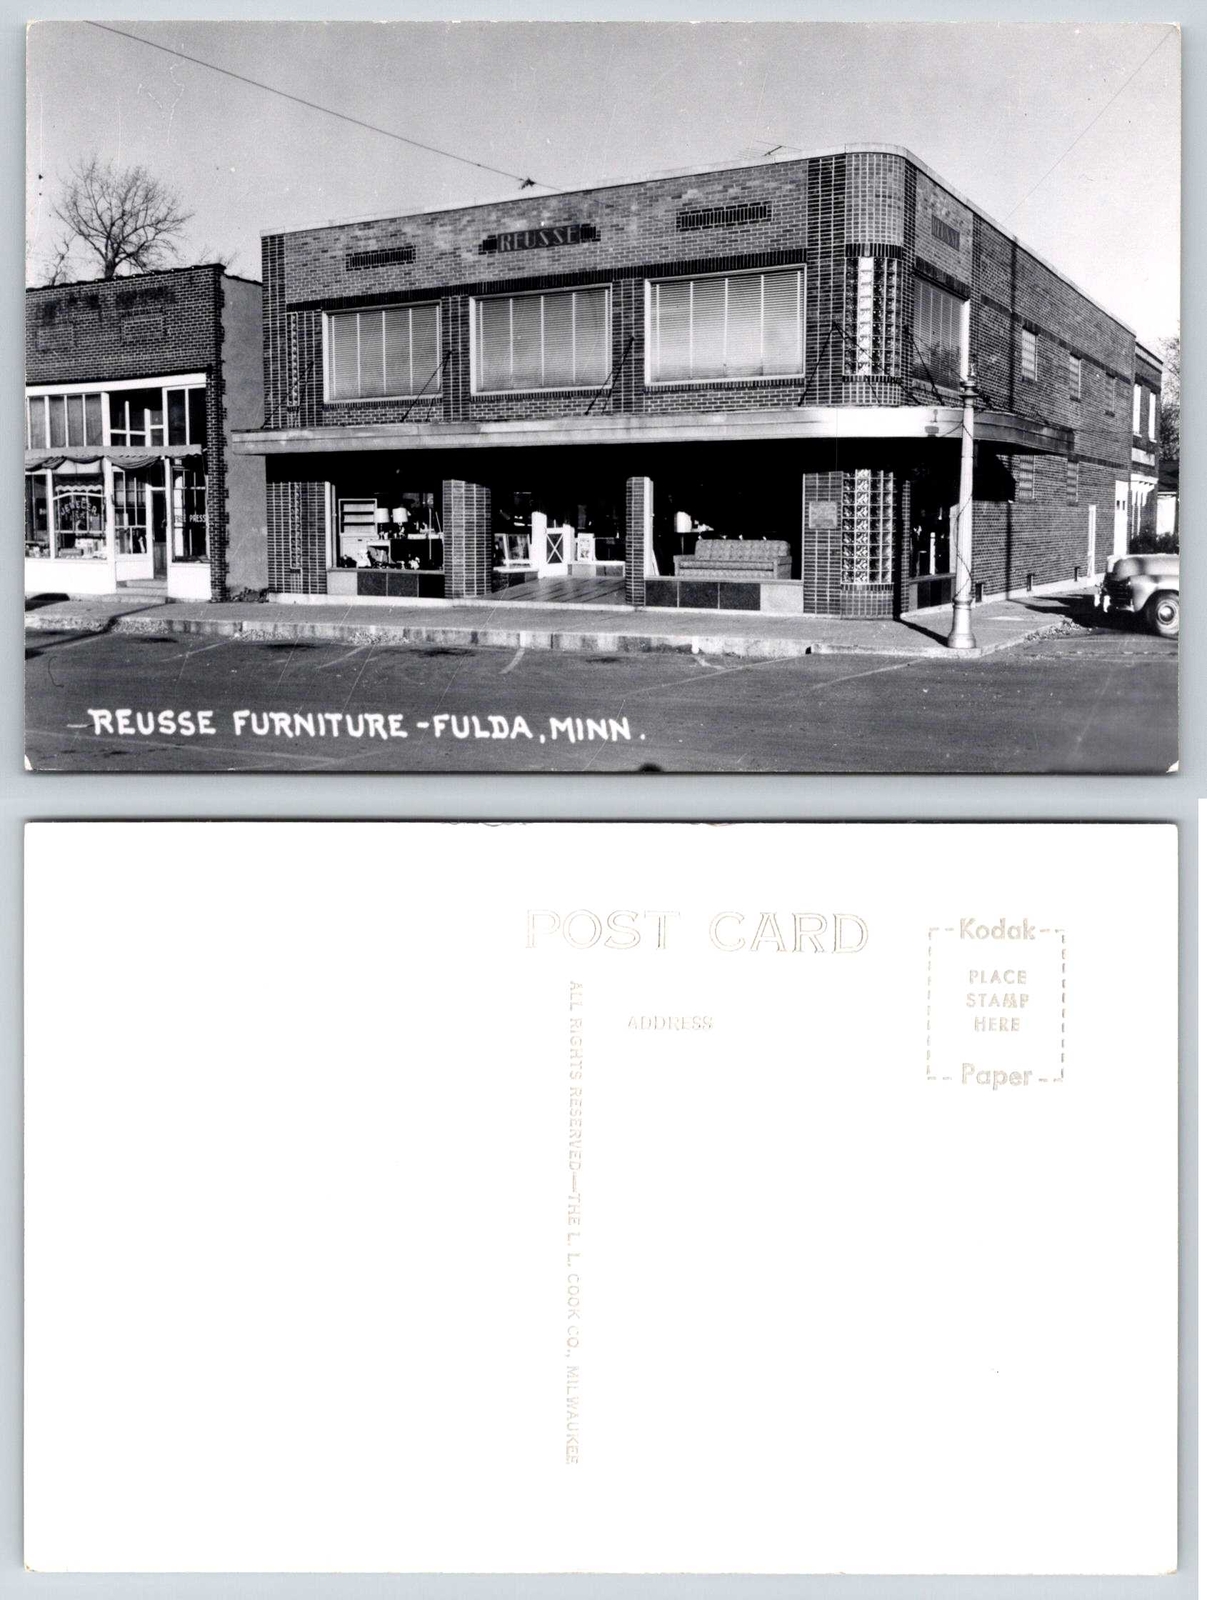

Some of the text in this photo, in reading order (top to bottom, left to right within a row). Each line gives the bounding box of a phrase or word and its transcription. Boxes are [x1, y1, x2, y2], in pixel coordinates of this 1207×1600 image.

[500, 226, 577, 251] REUSSE
[189, 514, 207, 523] PRESS
[525, 909, 869, 955] POST CARD
[959, 917, 1036, 941] Kodak
[968, 969, 1027, 985] PLACE
[569, 980, 584, 1012] ALL
[965, 992, 1030, 1009] STAMP
[627, 1015, 714, 1032] ADDRESS
[974, 1016, 1020, 1033] HERE
[568, 1017, 584, 1080] RIGHTS
[961, 1062, 1033, 1092] Paper
[566, 1231, 581, 1247] L.
[566, 1252, 581, 1268] L.
[566, 1273, 581, 1320] COOK
[564, 1325, 580, 1358] CO.,
[564, 1365, 580, 1465] MILWAUKEE
